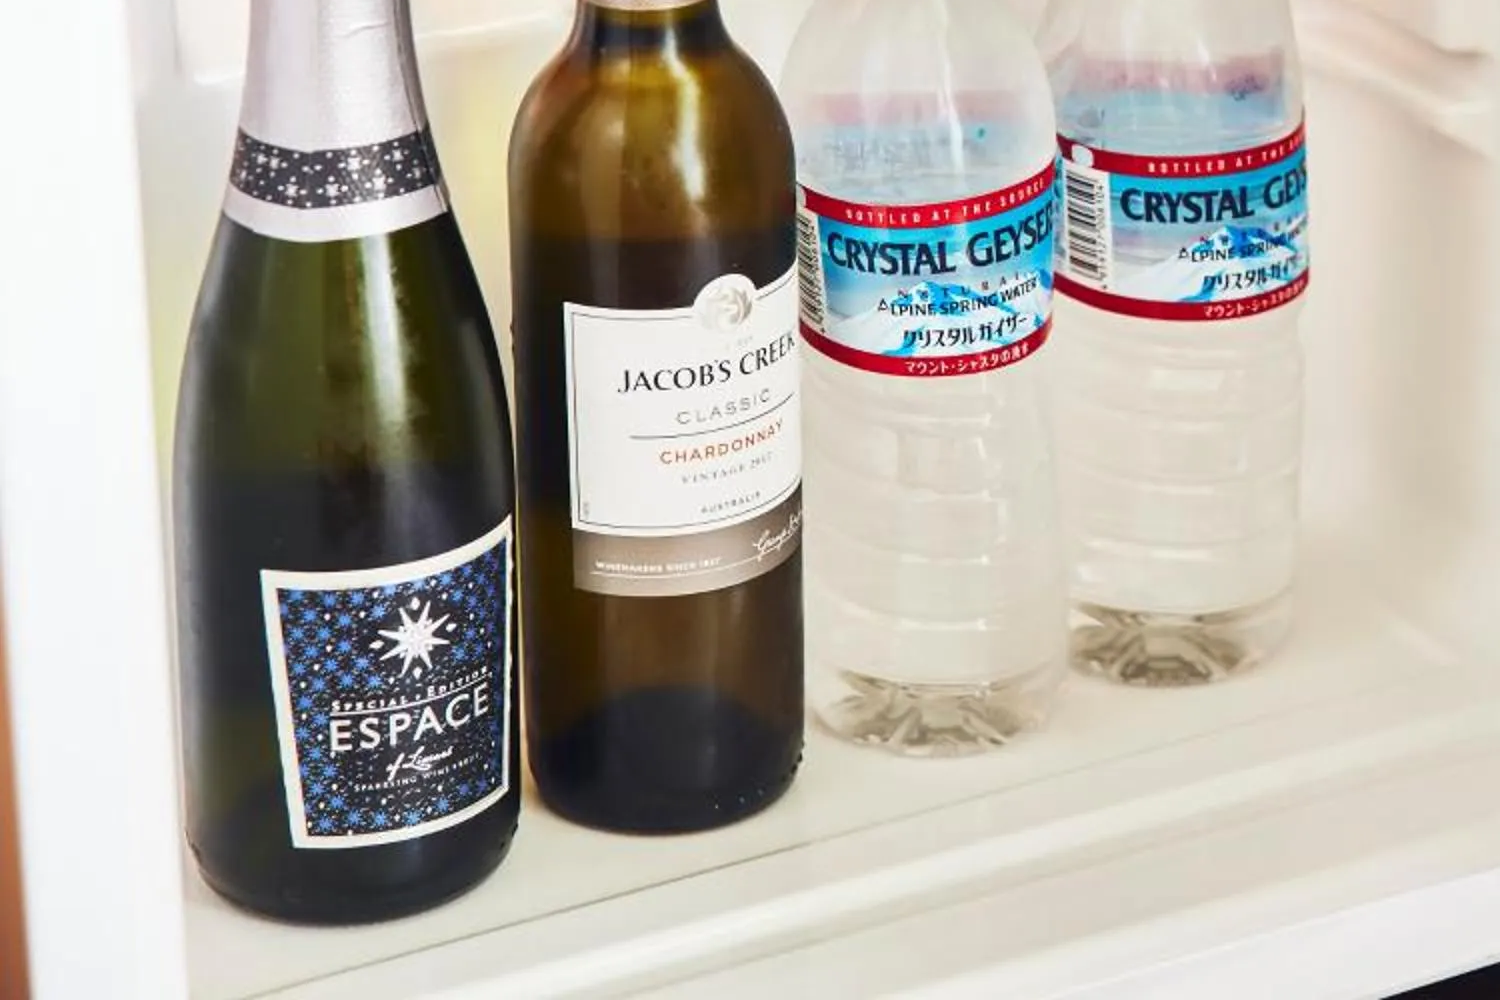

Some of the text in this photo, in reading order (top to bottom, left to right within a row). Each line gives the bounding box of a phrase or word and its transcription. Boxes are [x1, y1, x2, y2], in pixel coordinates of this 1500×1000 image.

[1235, 155, 1253, 169] AT
[845, 209, 920, 225] BOTTLED
[932, 209, 950, 222] AT
[963, 201, 991, 217] THE
[1120, 185, 1254, 223] CRYSTAL
[826, 231, 957, 277] CRYSTAL
[877, 276, 1038, 317] ALPINE SPRING WATER
[618, 358, 731, 394] JACOB'S
[676, 388, 771, 425] CLASSIC
[659, 419, 783, 465] CHARDONNAY
[682, 463, 745, 484] VINTAGE
[329, 682, 489, 751] ESPACE
